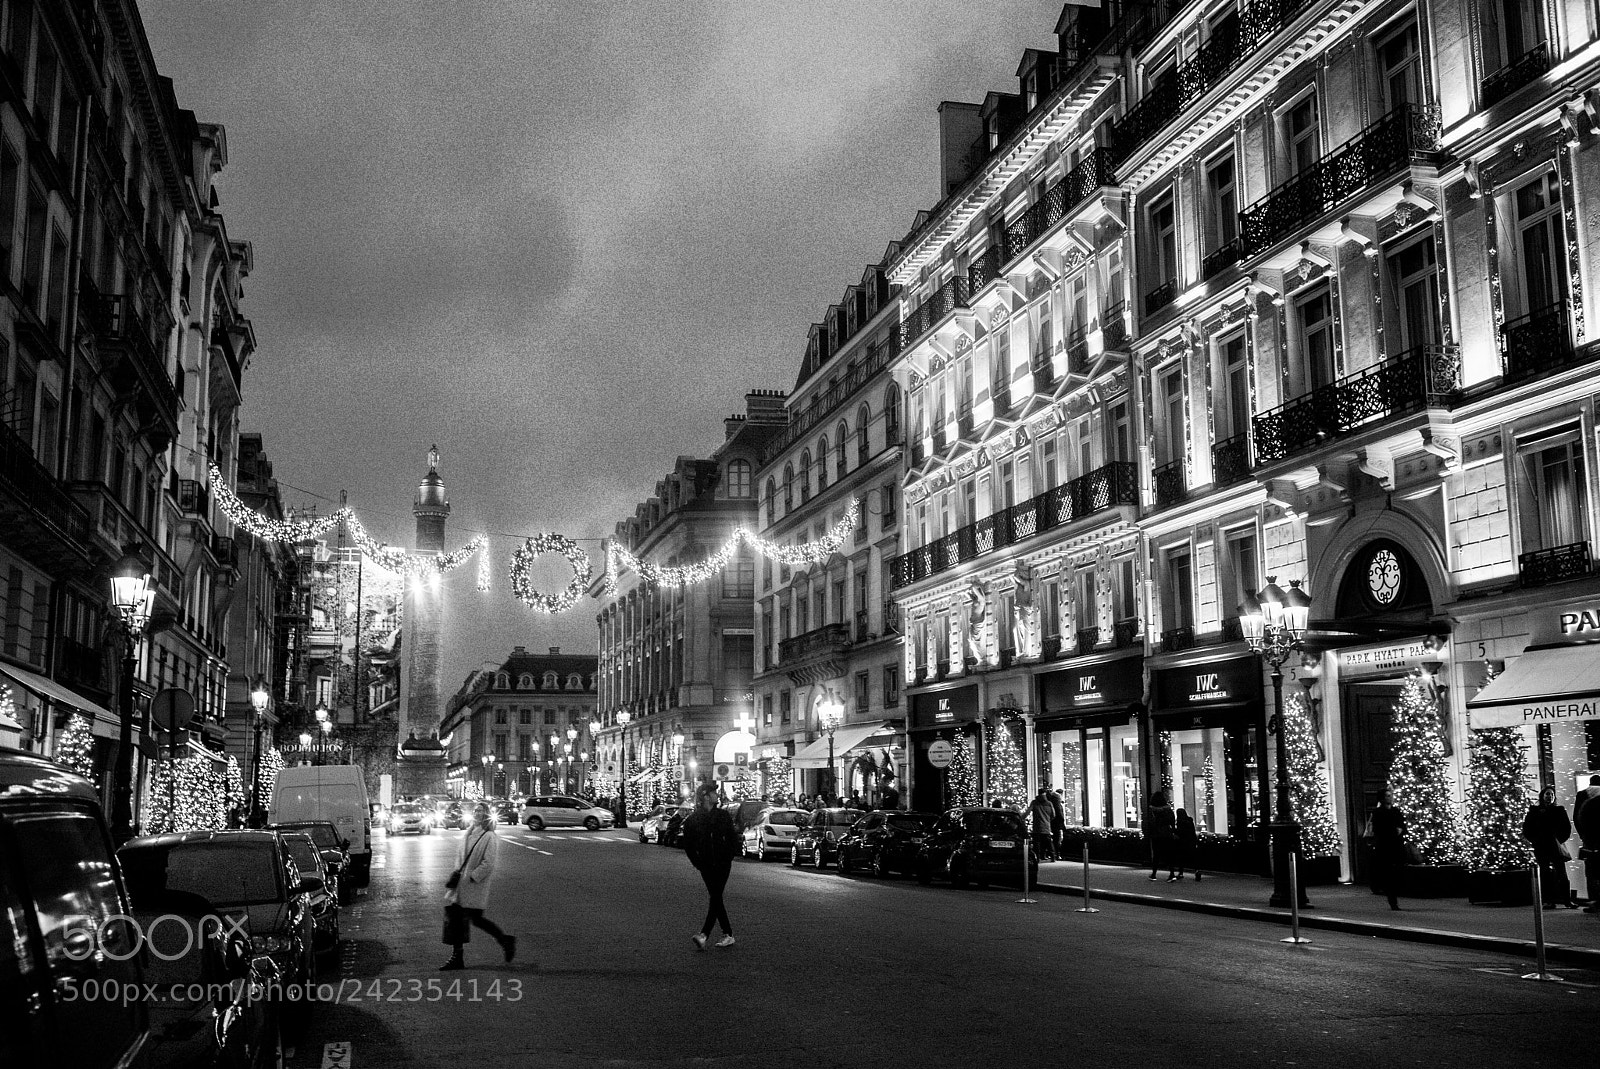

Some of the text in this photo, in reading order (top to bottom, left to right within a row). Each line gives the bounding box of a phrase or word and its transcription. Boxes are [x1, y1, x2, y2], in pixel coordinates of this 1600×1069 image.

[1346, 652, 1370, 665] PARK
[1374, 647, 1405, 662] HYATT
[1479, 641, 1486, 658] 5
[1196, 673, 1219, 692] IWC
[1290, 668, 1296, 681] 5
[1079, 675, 1096, 692] IWC
[938, 698, 950, 711] IWC
[1523, 702, 1597, 721] PANERAI
[738, 756, 745, 764] P
